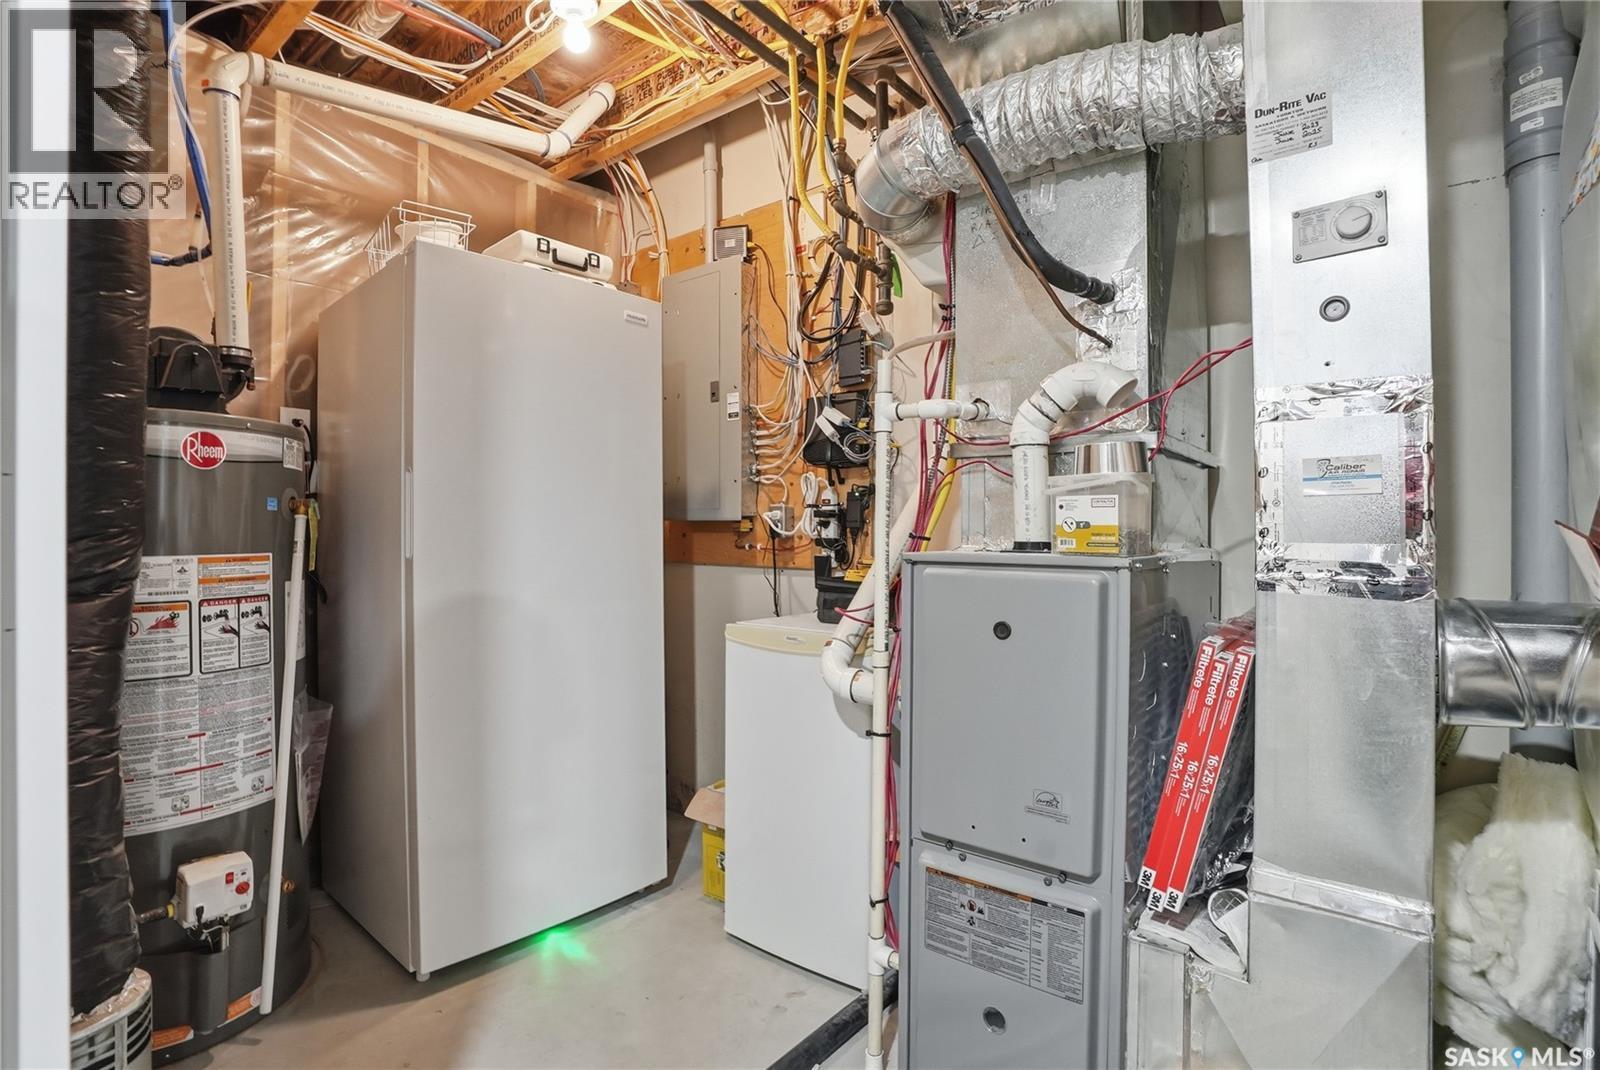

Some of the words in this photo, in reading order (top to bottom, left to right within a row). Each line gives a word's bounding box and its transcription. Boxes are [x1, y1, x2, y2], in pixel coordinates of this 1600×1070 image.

[187, 432, 223, 463] Rheem
[1325, 464, 1366, 472] Caliber
[1193, 645, 1213, 688] Filtrete
[1204, 661, 1226, 706] Filtrete
[1226, 653, 1249, 698] Filtrete
[1169, 741, 1189, 779] 16x25x1
[1199, 754, 1219, 795] 16x25x1
[1180, 760, 1199, 800] 16x25x1
[1141, 870, 1152, 887] 3M
[1150, 892, 1162, 909] 3M
[1166, 891, 1179, 909] 3M
